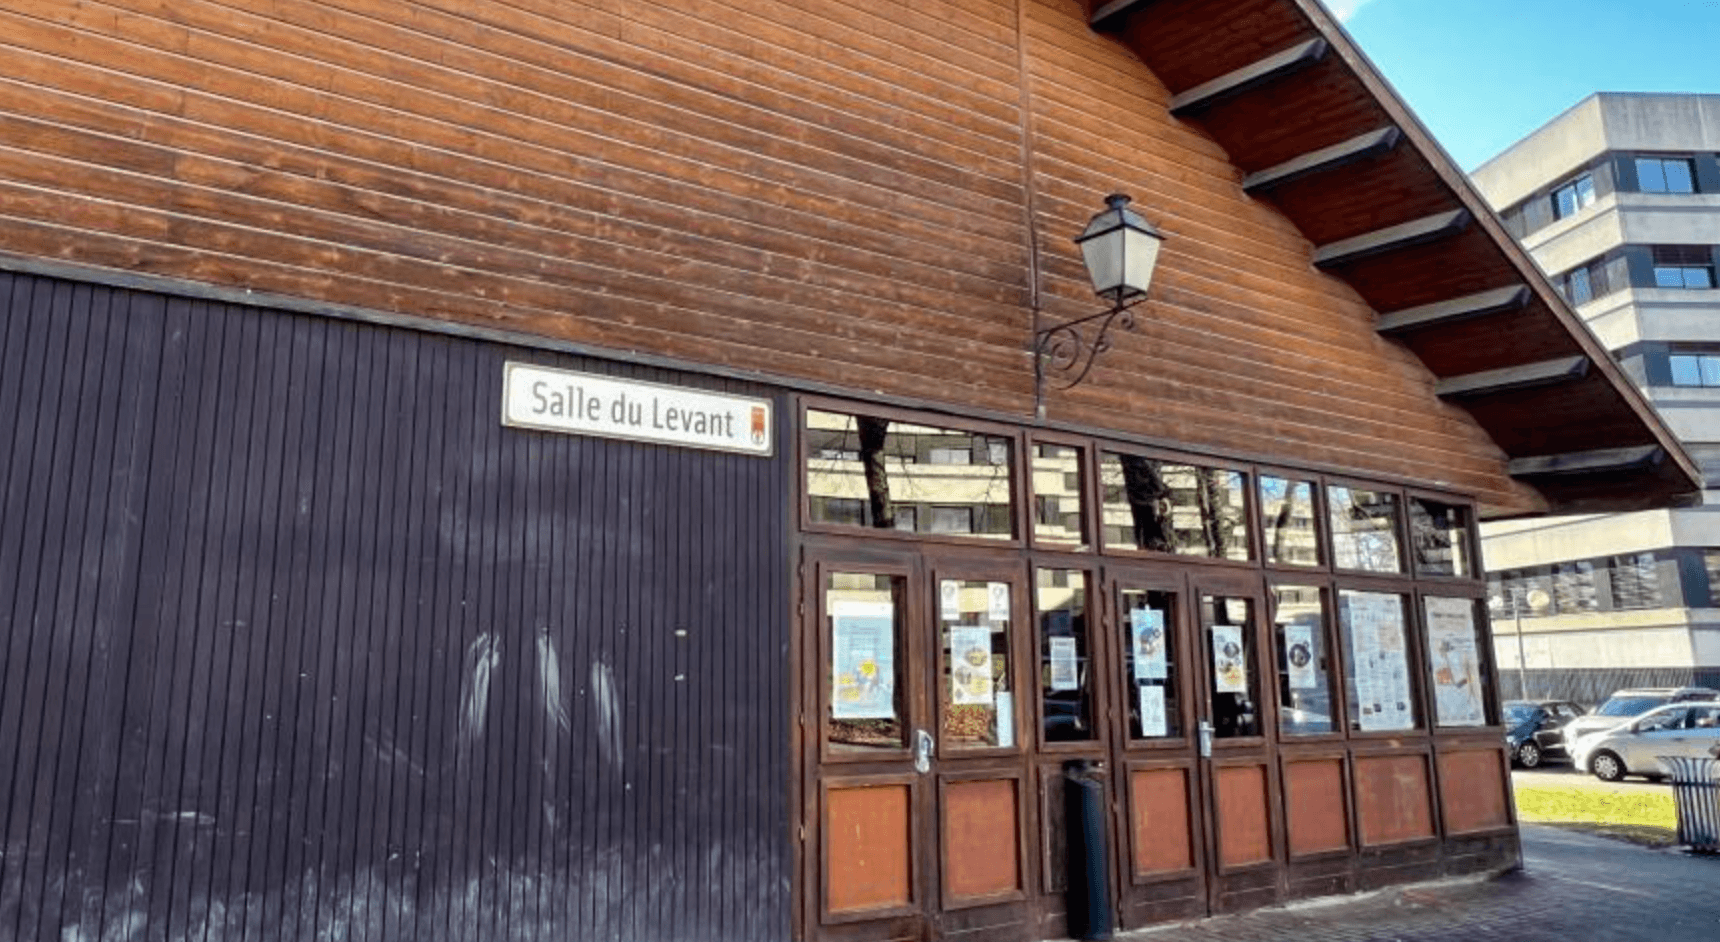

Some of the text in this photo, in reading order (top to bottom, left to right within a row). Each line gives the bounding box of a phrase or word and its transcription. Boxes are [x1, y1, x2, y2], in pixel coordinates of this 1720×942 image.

[532, 381, 735, 438] Salle du Levant
